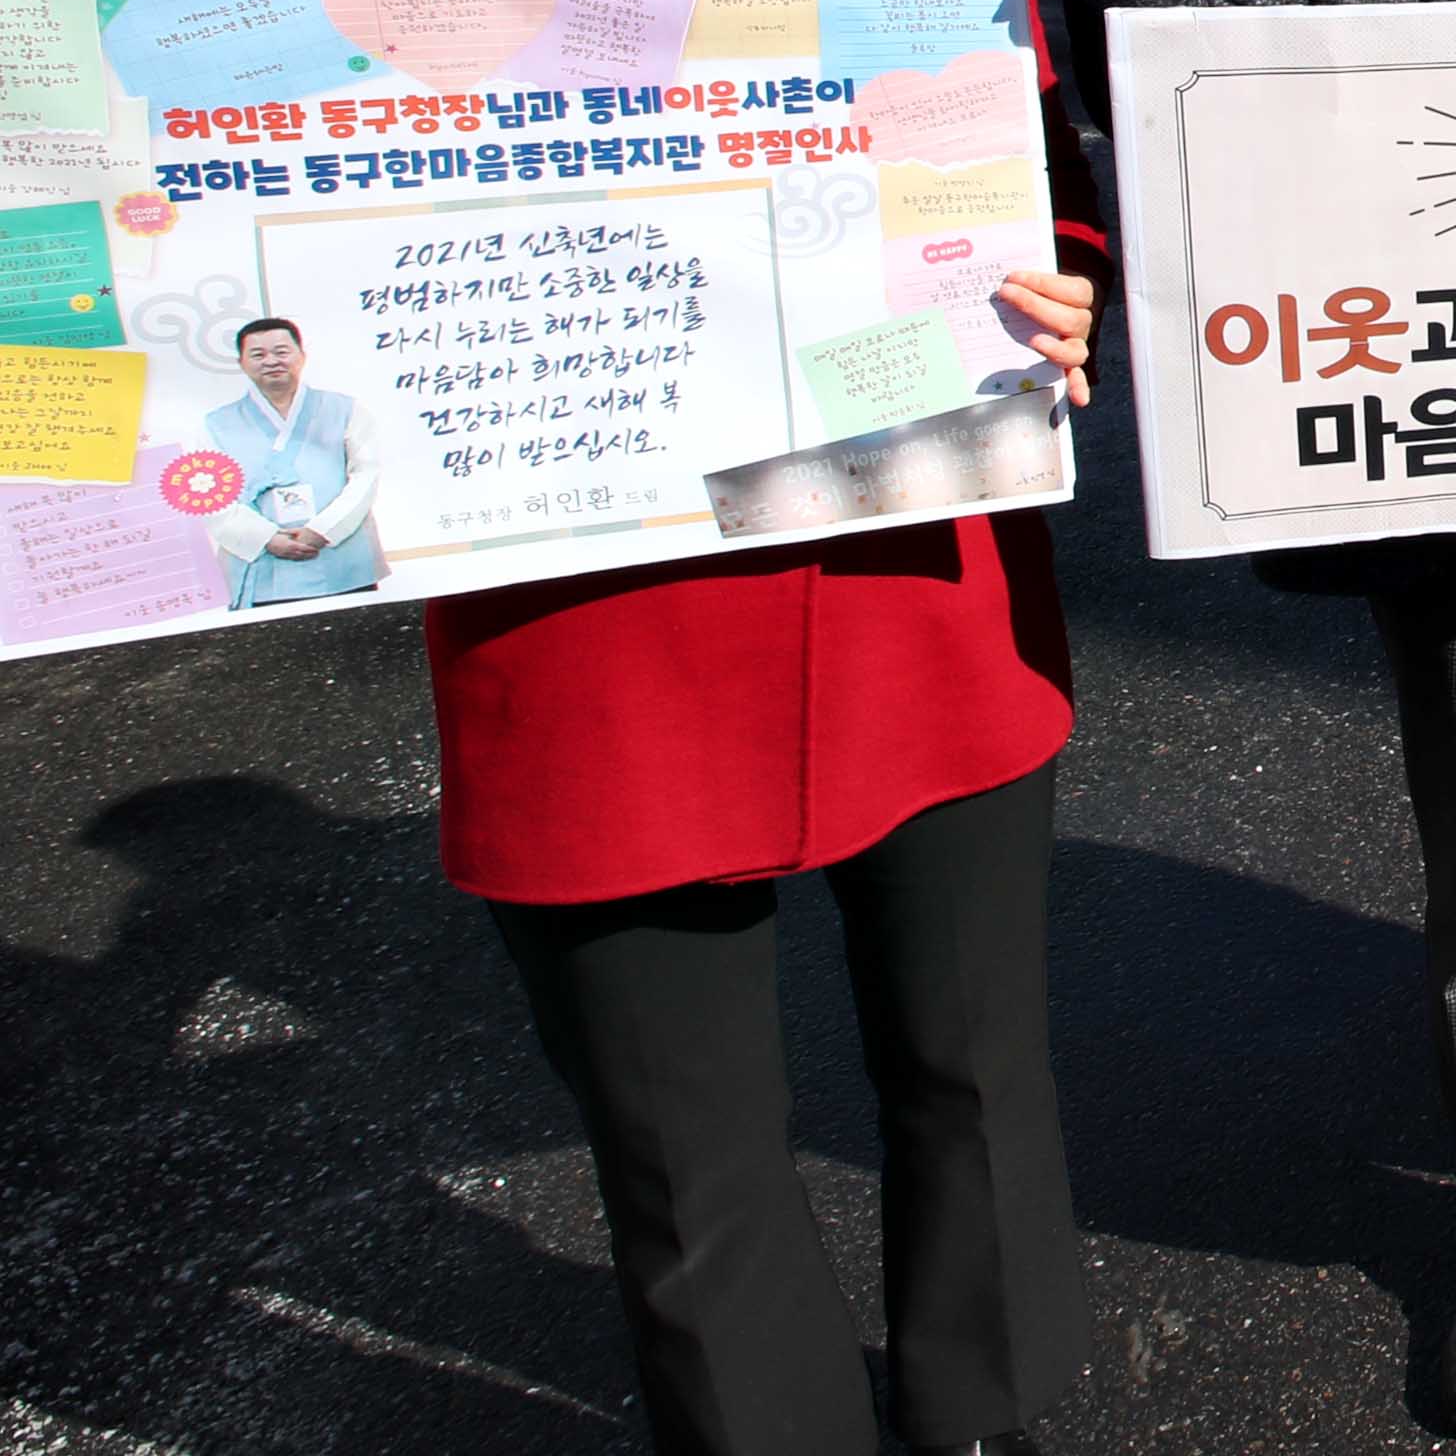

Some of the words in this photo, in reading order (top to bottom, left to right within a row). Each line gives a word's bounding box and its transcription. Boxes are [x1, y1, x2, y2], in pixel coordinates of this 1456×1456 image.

[163, 102, 306, 144] 허인환
[320, 89, 569, 140] 동구청장님과
[581, 75, 855, 120] 동네이웃사촌이
[155, 157, 289, 202] 전하는
[304, 132, 705, 194] 동구한마음종합복지관
[717, 124, 874, 170] 명절인사
[127, 206, 161, 216] GOOD
[130, 215, 161, 224] LUCK
[395, 232, 506, 271] 2021년
[520, 221, 669, 261] 신축년에는
[359, 272, 529, 316] 평범하지만
[541, 266, 616, 301] 소중한
[626, 256, 709, 295] 일상을
[376, 319, 442, 351] 다시
[454, 312, 534, 347] 누리는
[544, 306, 612, 338] 해가
[622, 293, 707, 334] 되기를
[396, 357, 519, 396] 마음담아
[532, 340, 696, 380] 희망합니다
[417, 396, 574, 437] 건강하시고
[583, 385, 647, 417] 새해
[660, 379, 683, 415] 복
[442, 442, 506, 479] 많이
[517, 429, 668, 467] 받으십시오.
[782, 458, 834, 485] 2021
[841, 445, 891, 470] Hope
[932, 427, 970, 448] Life
[436, 505, 513, 530] 동구청장
[521, 485, 616, 517] 허인환
[623, 488, 660, 505] 드림
